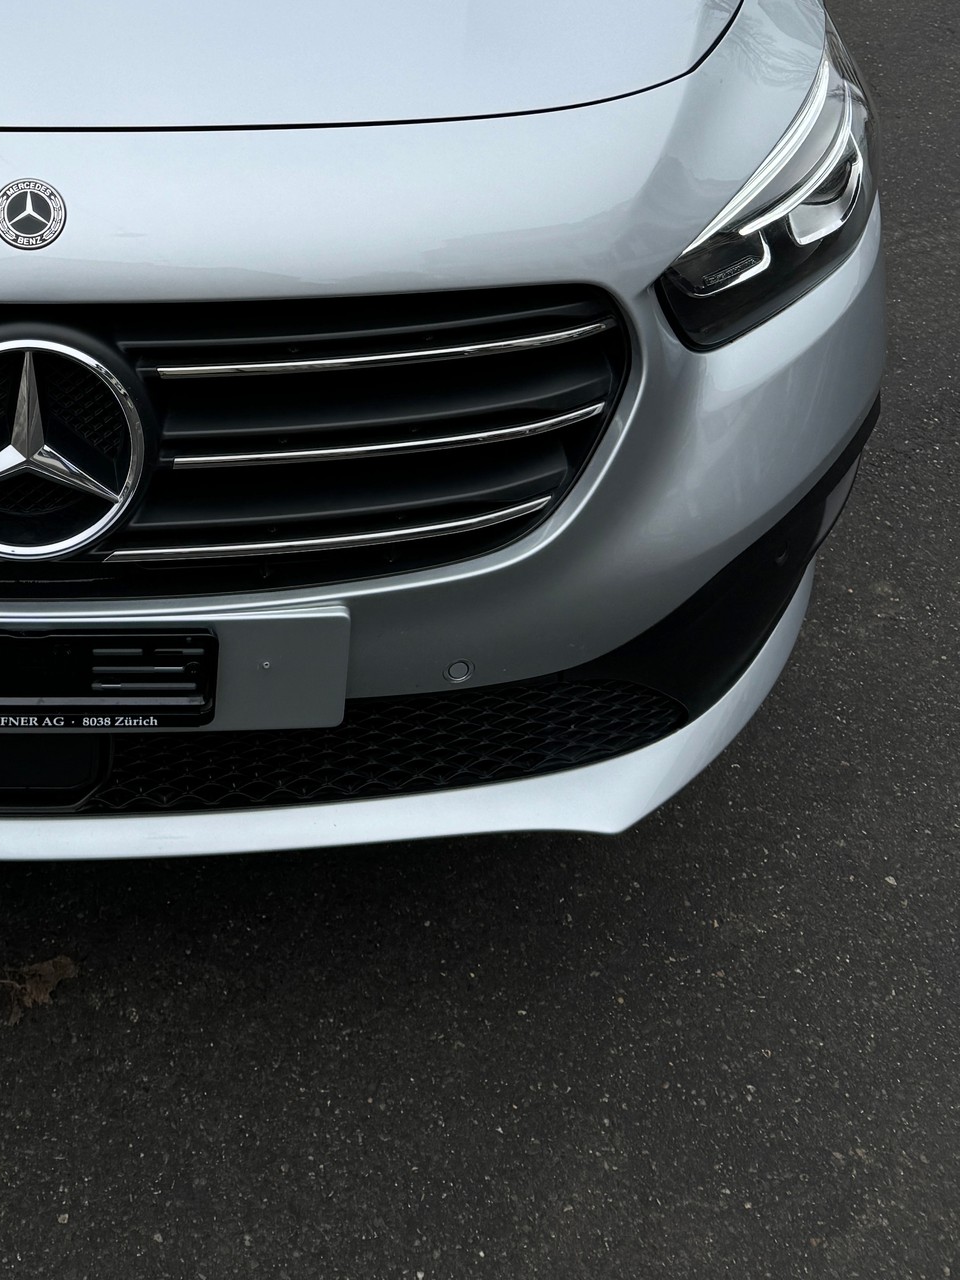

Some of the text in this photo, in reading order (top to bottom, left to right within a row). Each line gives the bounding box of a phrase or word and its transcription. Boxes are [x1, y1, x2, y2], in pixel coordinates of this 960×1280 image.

[6, 182, 52, 196] MERCEDES
[17, 236, 43, 245] BENZ
[42, 716, 65, 727] AG
[82, 717, 111, 726] 8038
[114, 716, 158, 727] Zürich
